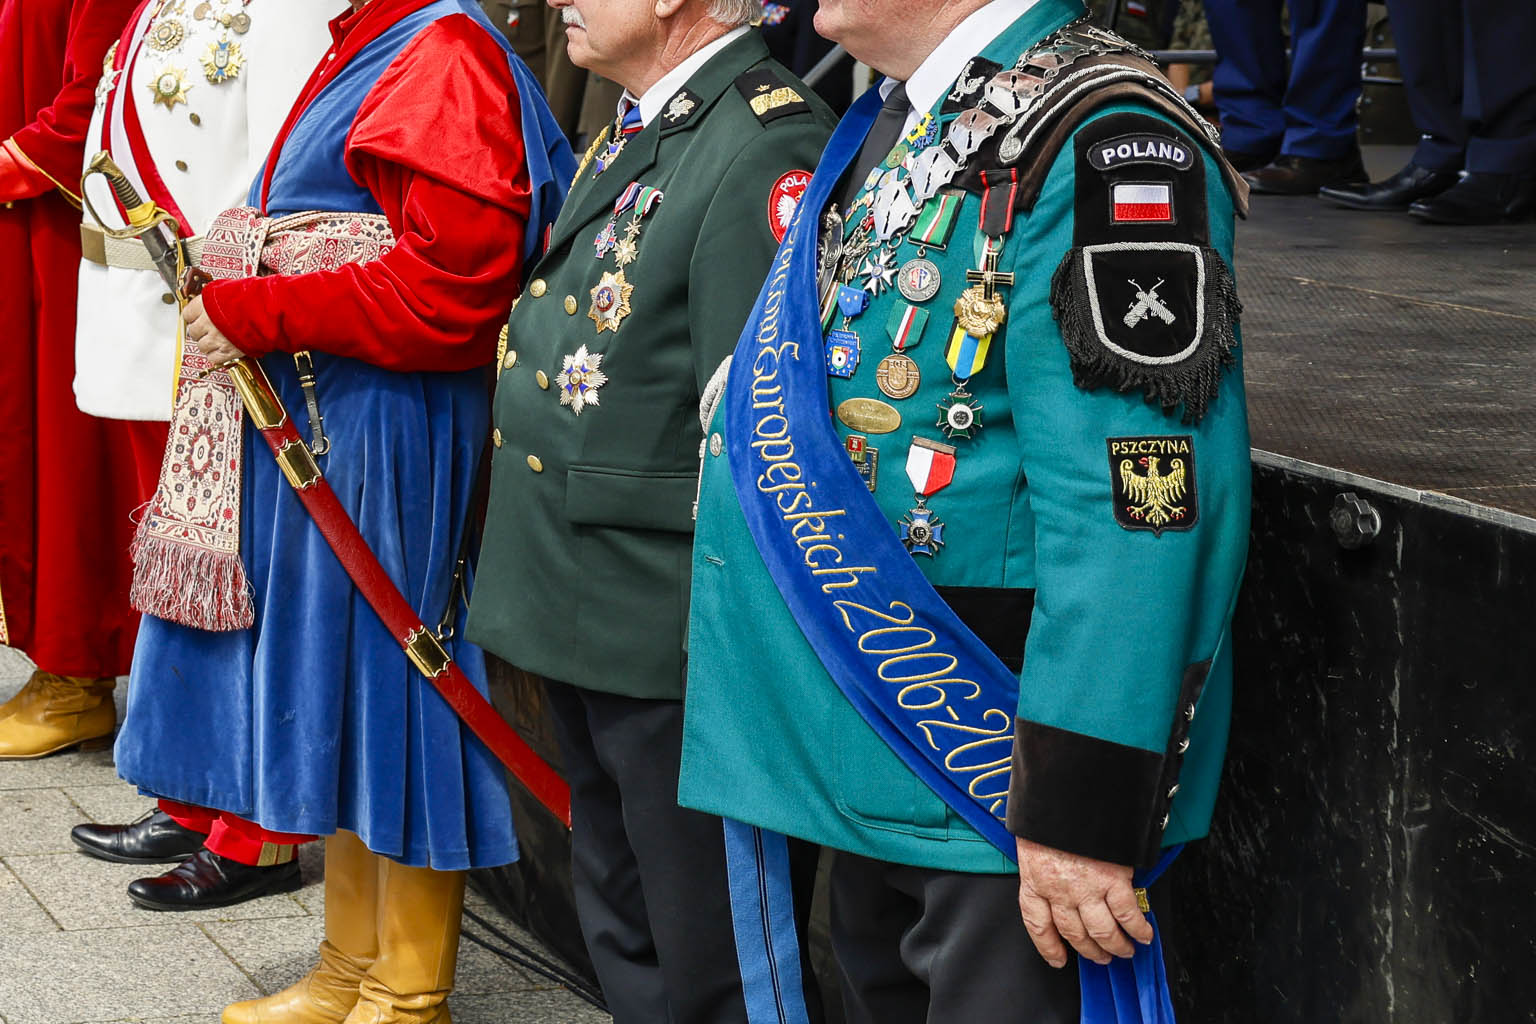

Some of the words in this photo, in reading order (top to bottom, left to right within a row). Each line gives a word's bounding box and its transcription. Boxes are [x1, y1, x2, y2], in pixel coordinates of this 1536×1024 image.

[1101, 141, 1186, 165] POLAND
[779, 175, 809, 193] POLA
[1111, 440, 1190, 456] PSZCZYNA
[751, 342, 876, 594] Europejskich
[833, 600, 1016, 822] 2006-200
